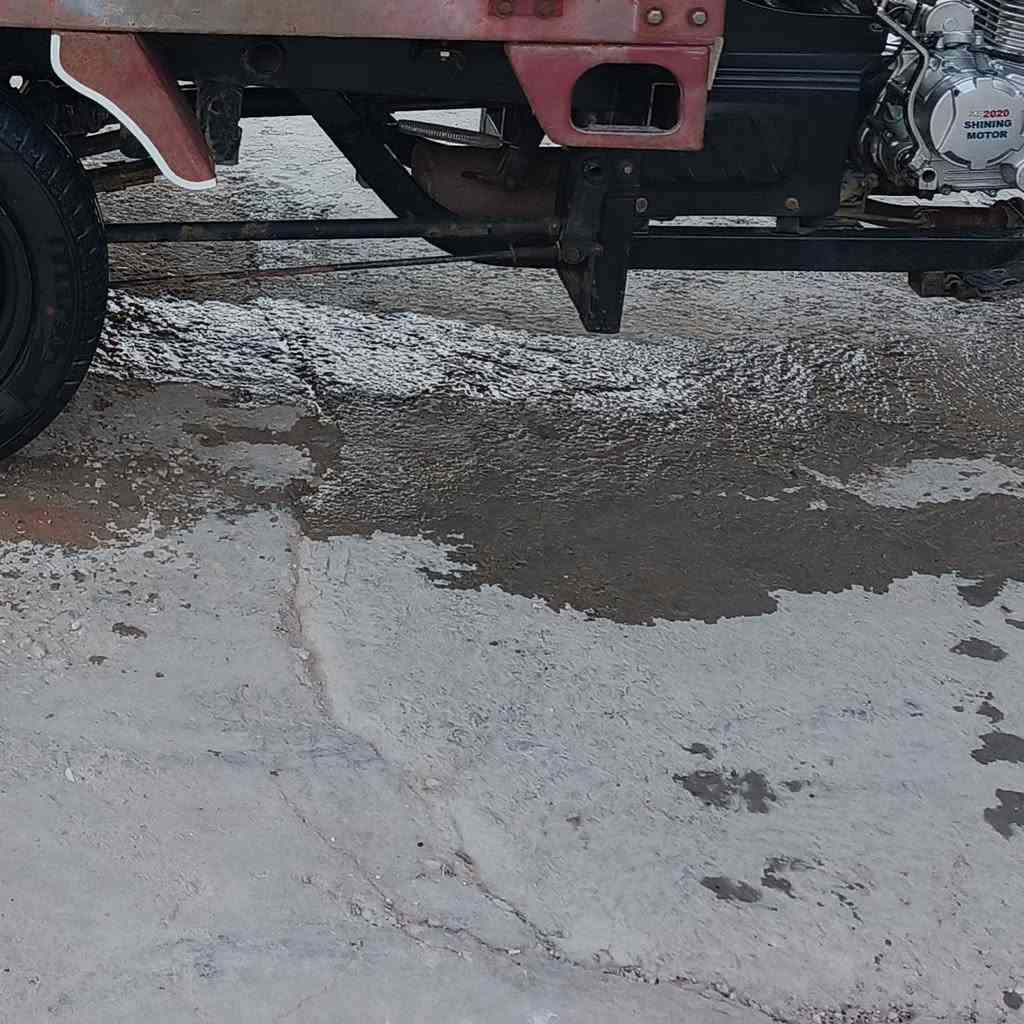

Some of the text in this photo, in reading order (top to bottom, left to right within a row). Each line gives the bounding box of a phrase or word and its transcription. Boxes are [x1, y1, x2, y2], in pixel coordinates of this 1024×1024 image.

[983, 109, 1009, 118] 2020
[963, 120, 1012, 129] SHINING
[967, 131, 1008, 140] MOTOR
